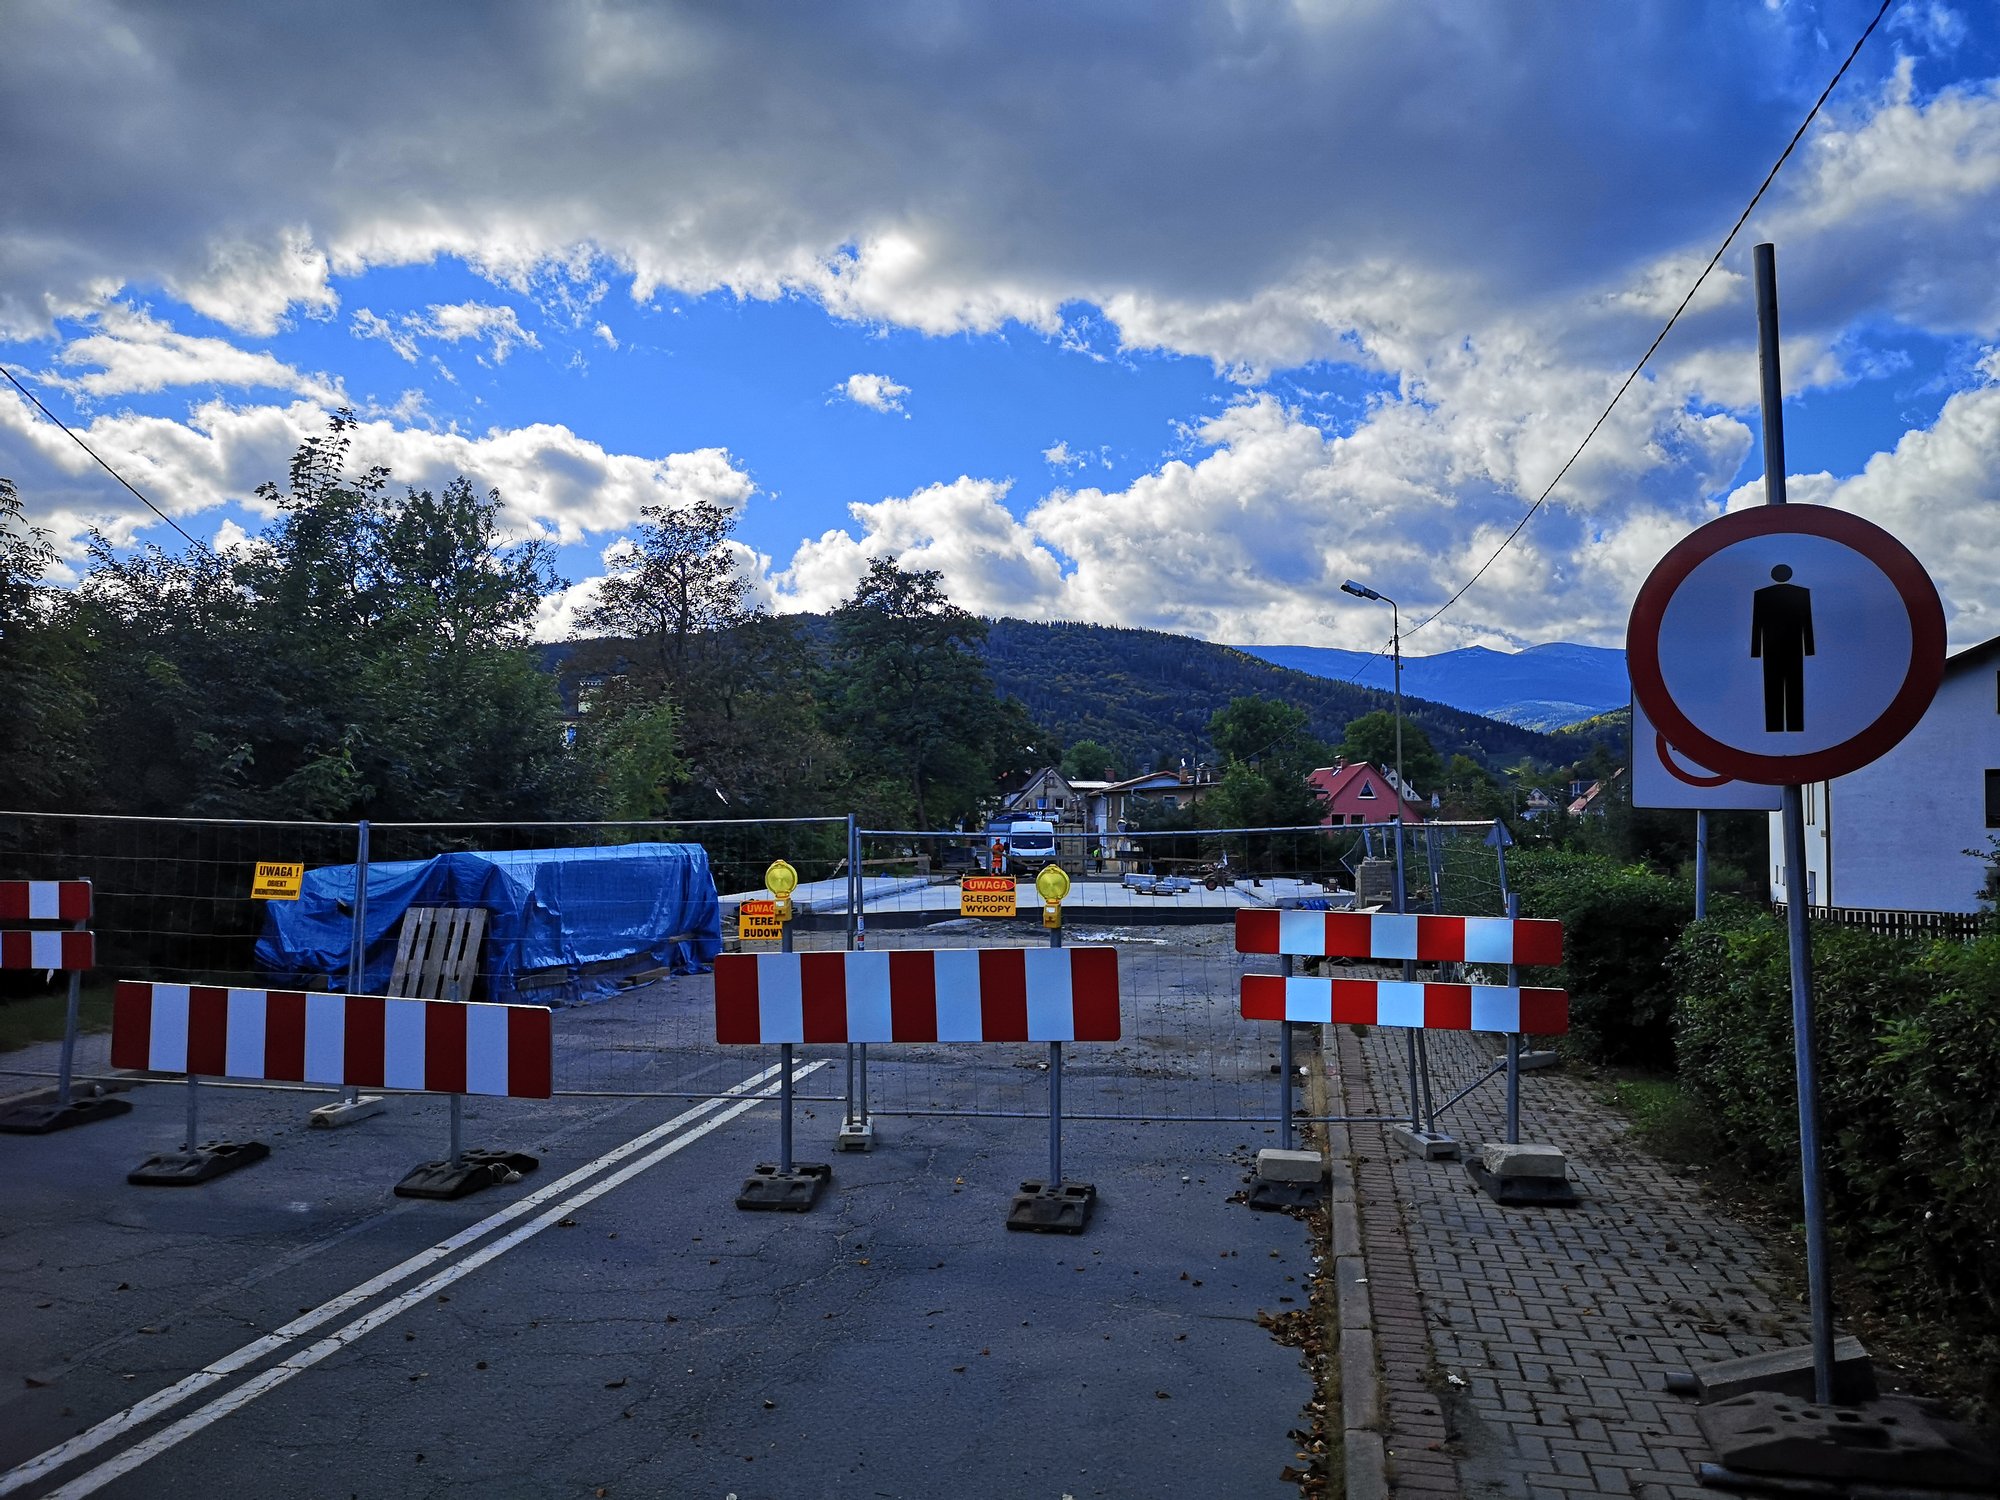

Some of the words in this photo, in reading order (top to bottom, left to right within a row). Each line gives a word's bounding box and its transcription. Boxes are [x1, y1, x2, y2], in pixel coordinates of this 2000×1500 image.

[259, 865, 293, 877] UWAGA
[969, 880, 1008, 890] UWAGA
[962, 894, 1015, 904] GŁĘBOKIE
[747, 904, 775, 913] UWAG
[965, 905, 1011, 913] WYKOPY
